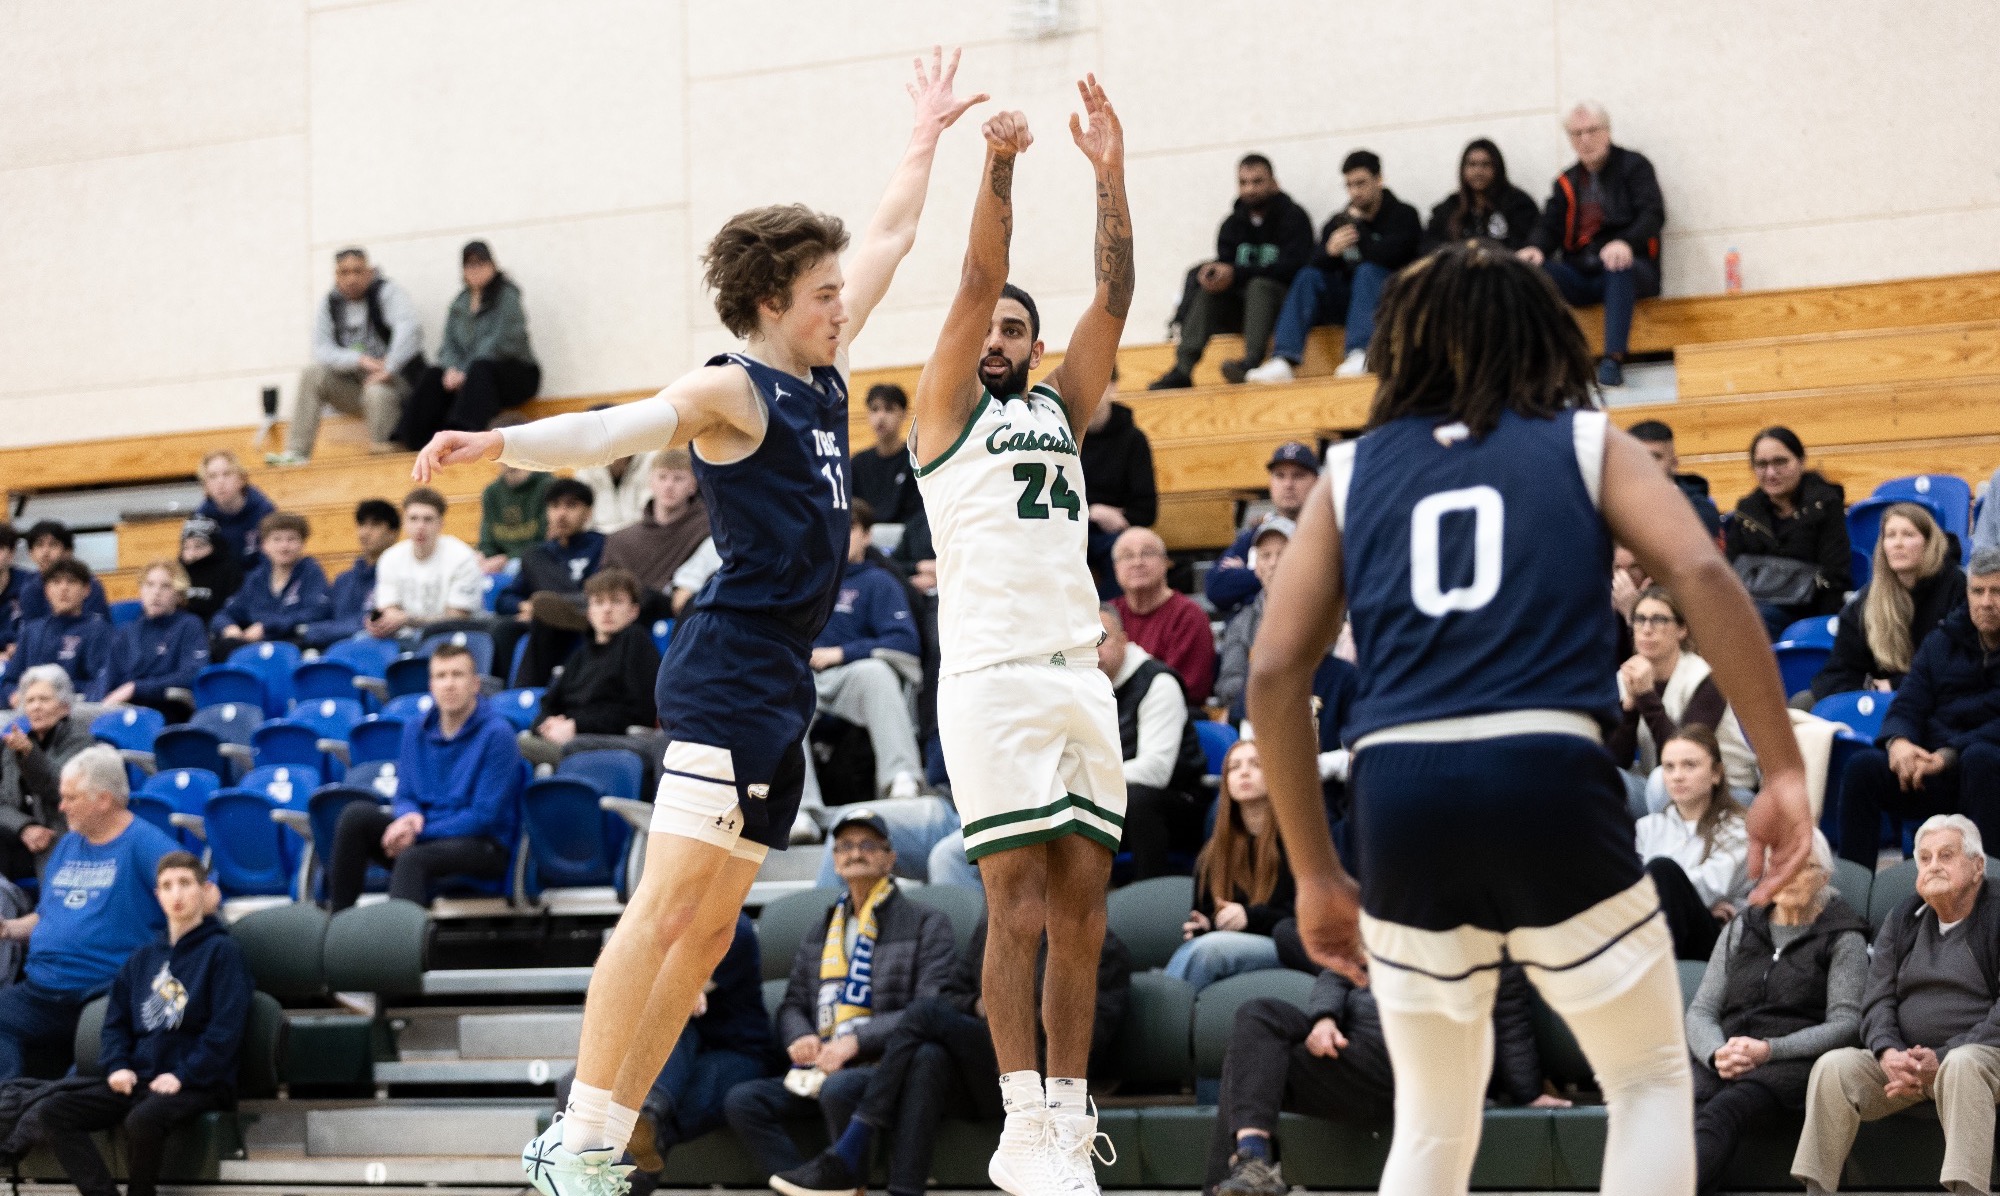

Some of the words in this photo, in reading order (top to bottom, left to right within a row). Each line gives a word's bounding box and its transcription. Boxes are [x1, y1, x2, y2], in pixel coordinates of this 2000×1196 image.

[821, 462, 848, 511] 11
[1012, 462, 1081, 522] 24
[1410, 484, 1505, 618] 0
